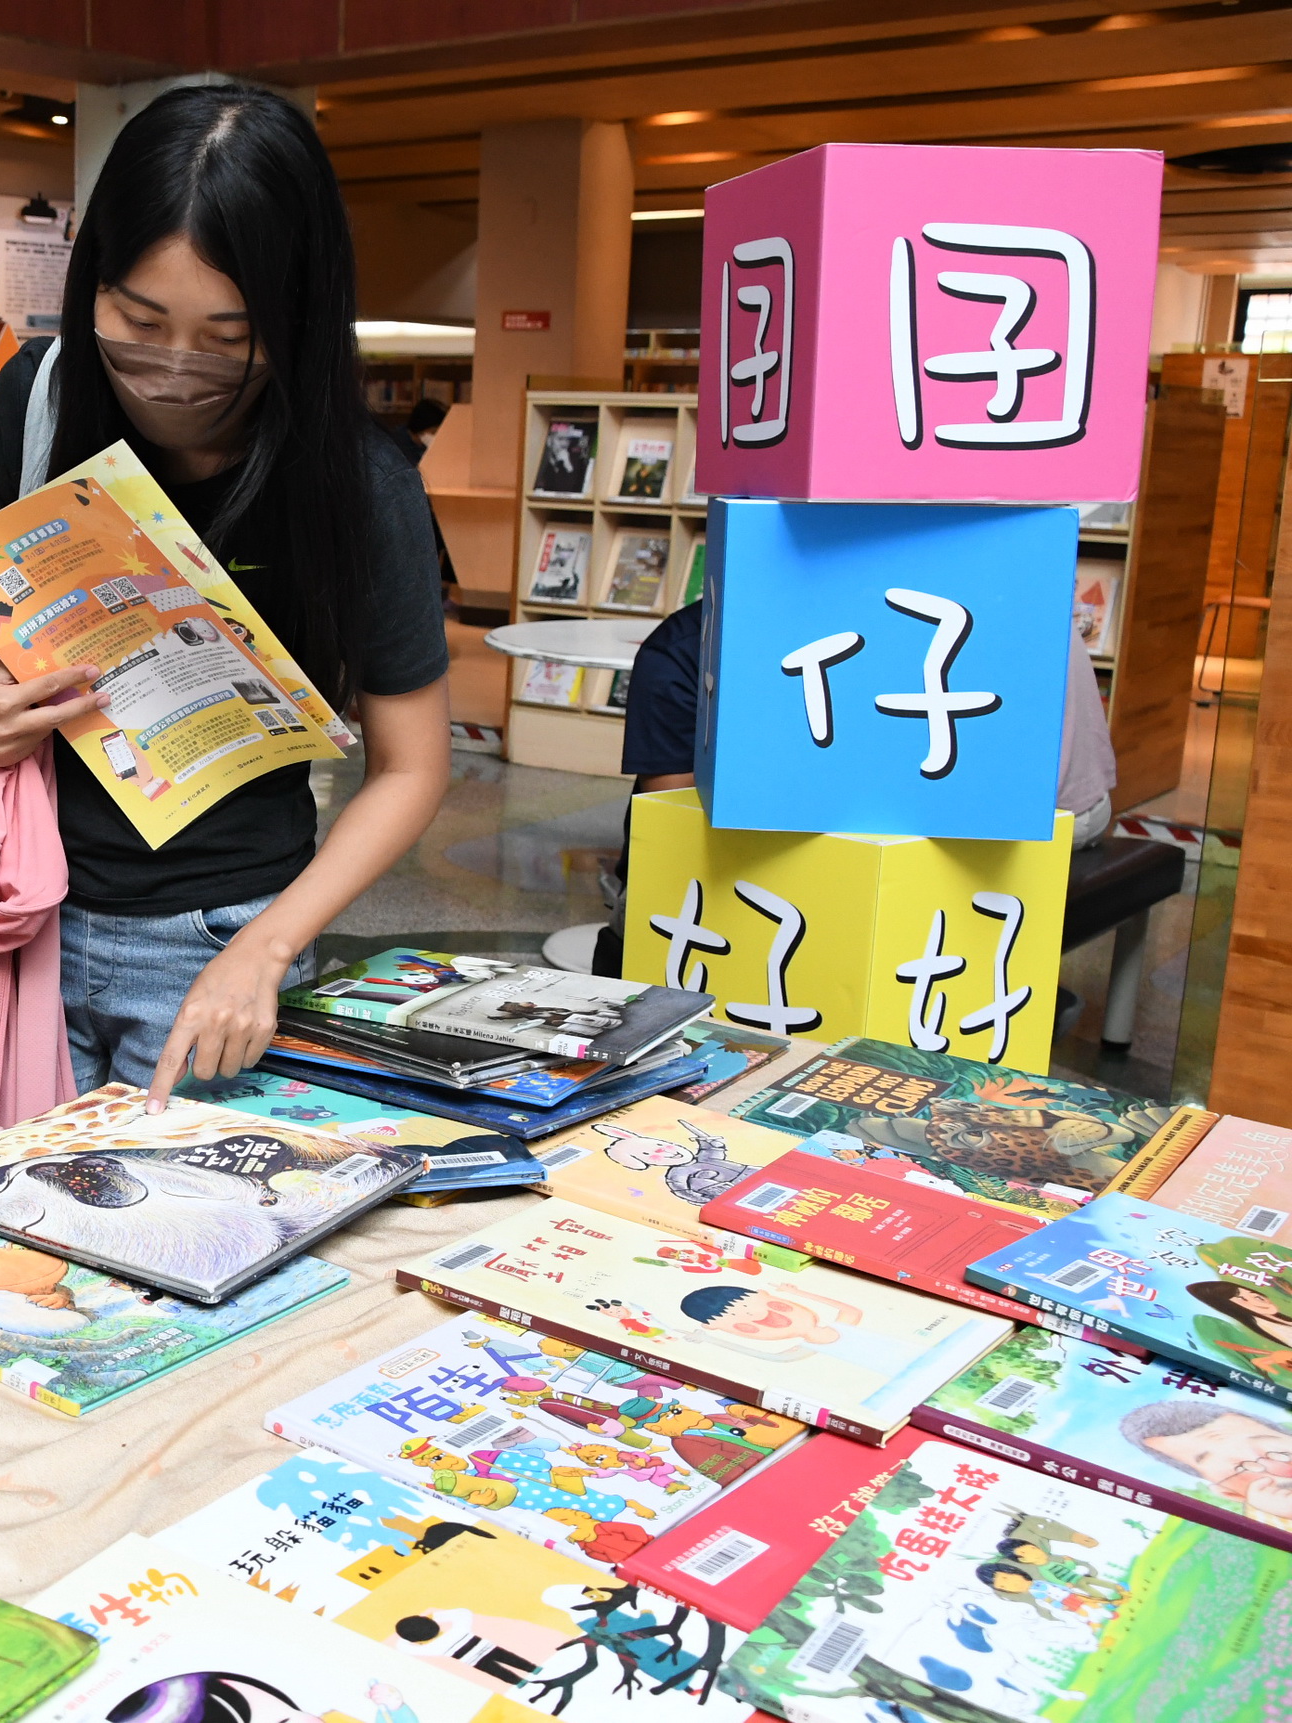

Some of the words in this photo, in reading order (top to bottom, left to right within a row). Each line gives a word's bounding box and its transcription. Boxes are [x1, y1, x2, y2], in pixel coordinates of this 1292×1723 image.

[781, 586, 1003, 781] 仔
[895, 891, 1032, 1064] 好
[795, 1073, 831, 1094] HOW
[821, 1061, 852, 1077] THE
[815, 1065, 882, 1102] LEOPARD
[853, 1087, 881, 1104] GOT
[878, 1073, 904, 1090] HIS
[875, 1077, 937, 1114] CLAWS
[311, 1380, 403, 1432] 怎麼面對
[364, 1347, 543, 1434] 陌生人
[229, 1491, 366, 1577] 玩躲貓貓
